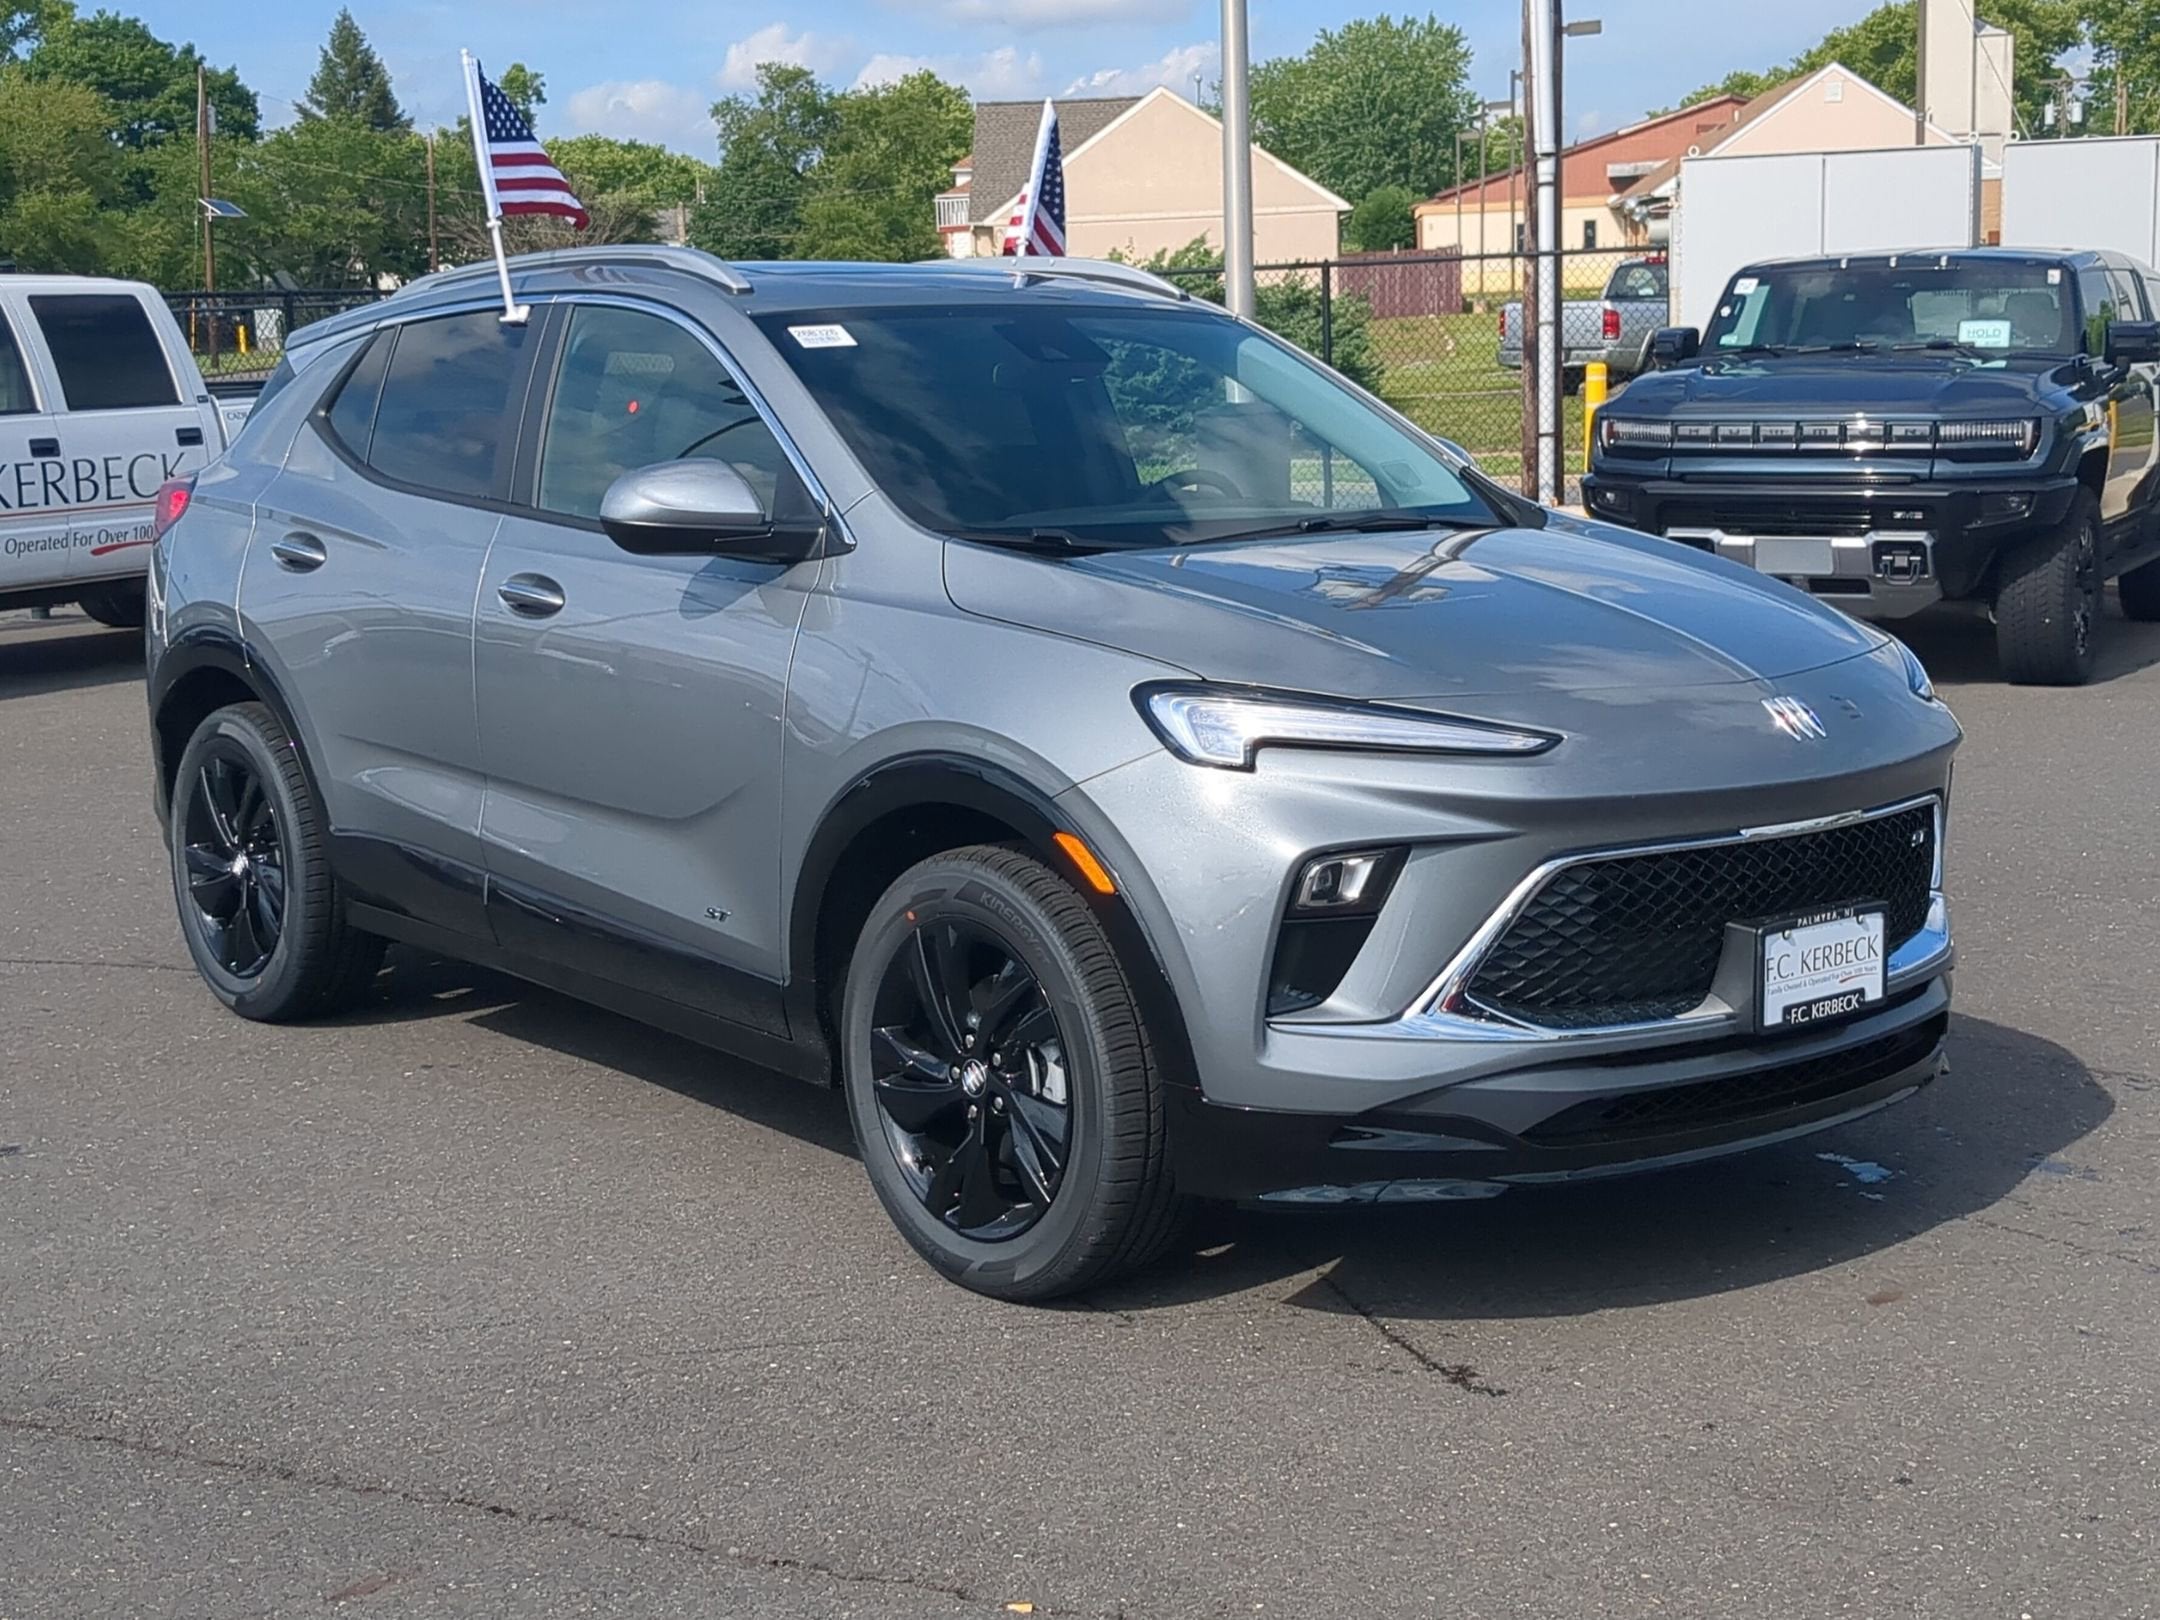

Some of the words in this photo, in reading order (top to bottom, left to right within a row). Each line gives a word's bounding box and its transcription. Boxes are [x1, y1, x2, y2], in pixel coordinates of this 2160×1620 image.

[1966, 328, 2002, 338] HOLD
[4, 531, 70, 559] Operated
[72, 530, 95, 547] For
[97, 528, 129, 545] Over
[132, 523, 154, 540] 100
[704, 906, 732, 922] ST
[1765, 953, 1794, 983] F.C.
[1800, 933, 1879, 975] KERBECK
[1811, 992, 1860, 1020] KERBECK
